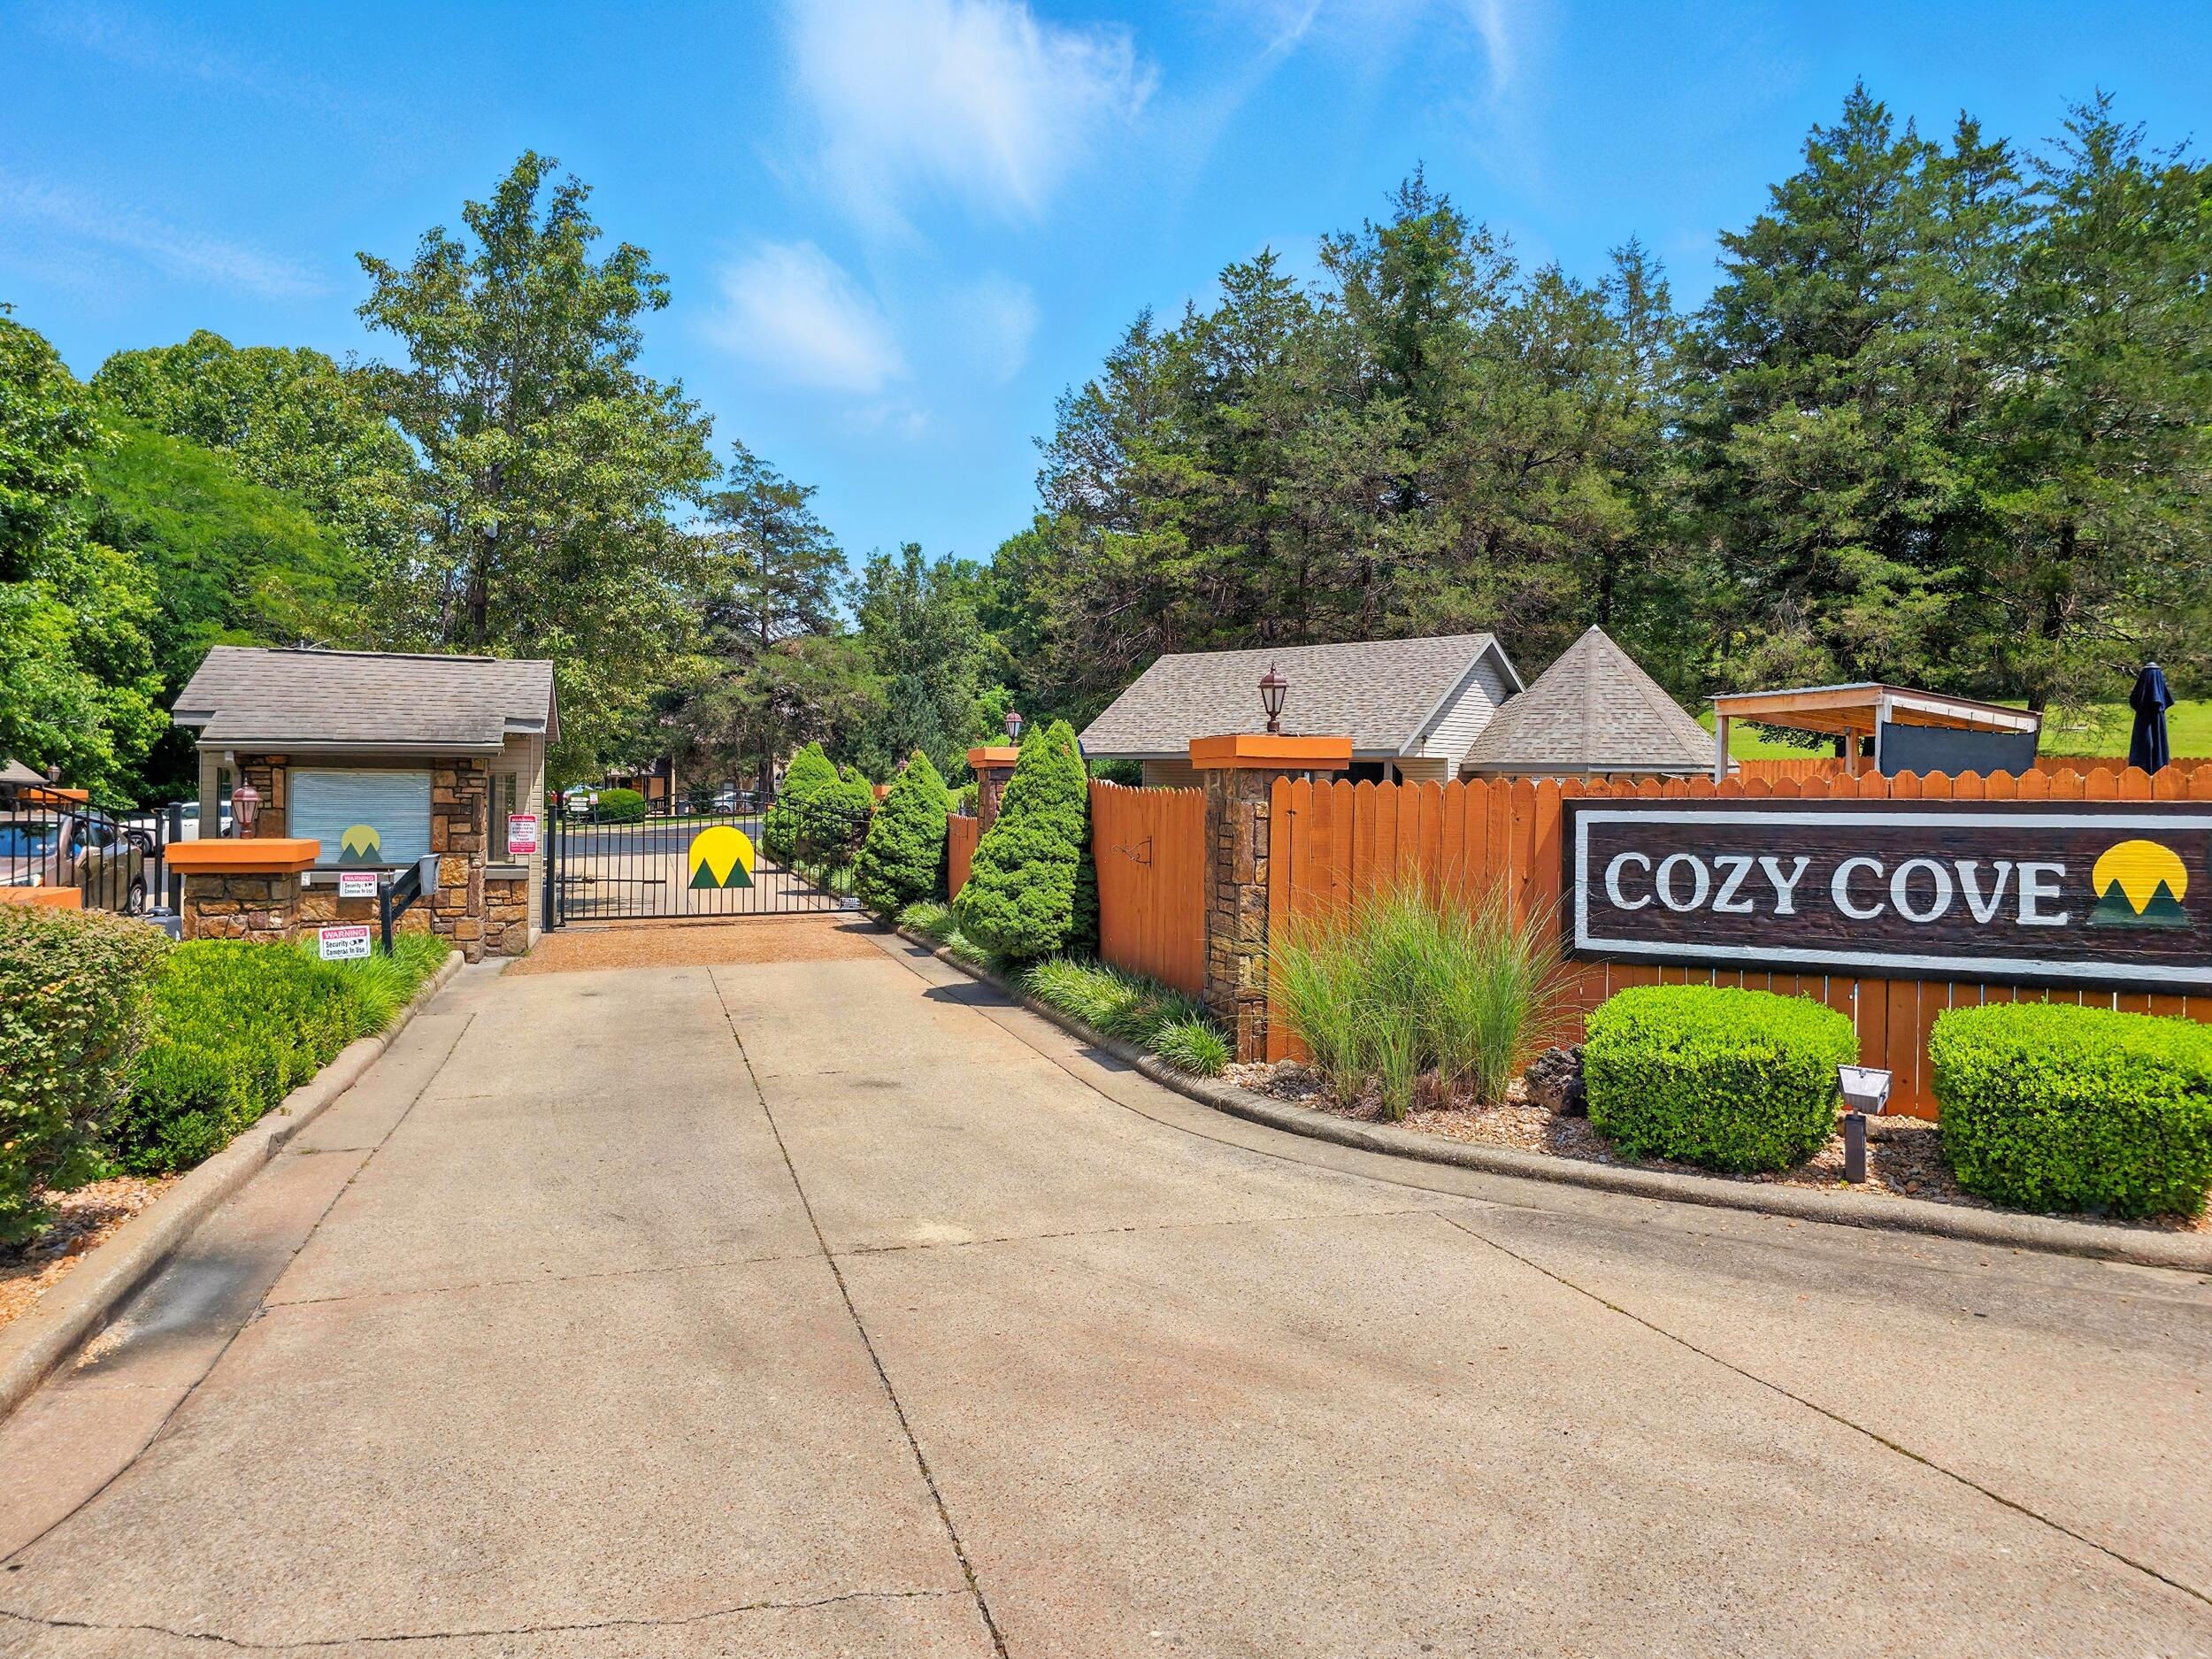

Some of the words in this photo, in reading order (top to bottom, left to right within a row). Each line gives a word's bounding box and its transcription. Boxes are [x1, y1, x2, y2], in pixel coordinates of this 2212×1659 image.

[1605, 852, 1810, 915] COZY
[1831, 856, 2068, 926] COVE
[325, 929, 365, 938] WARNING
